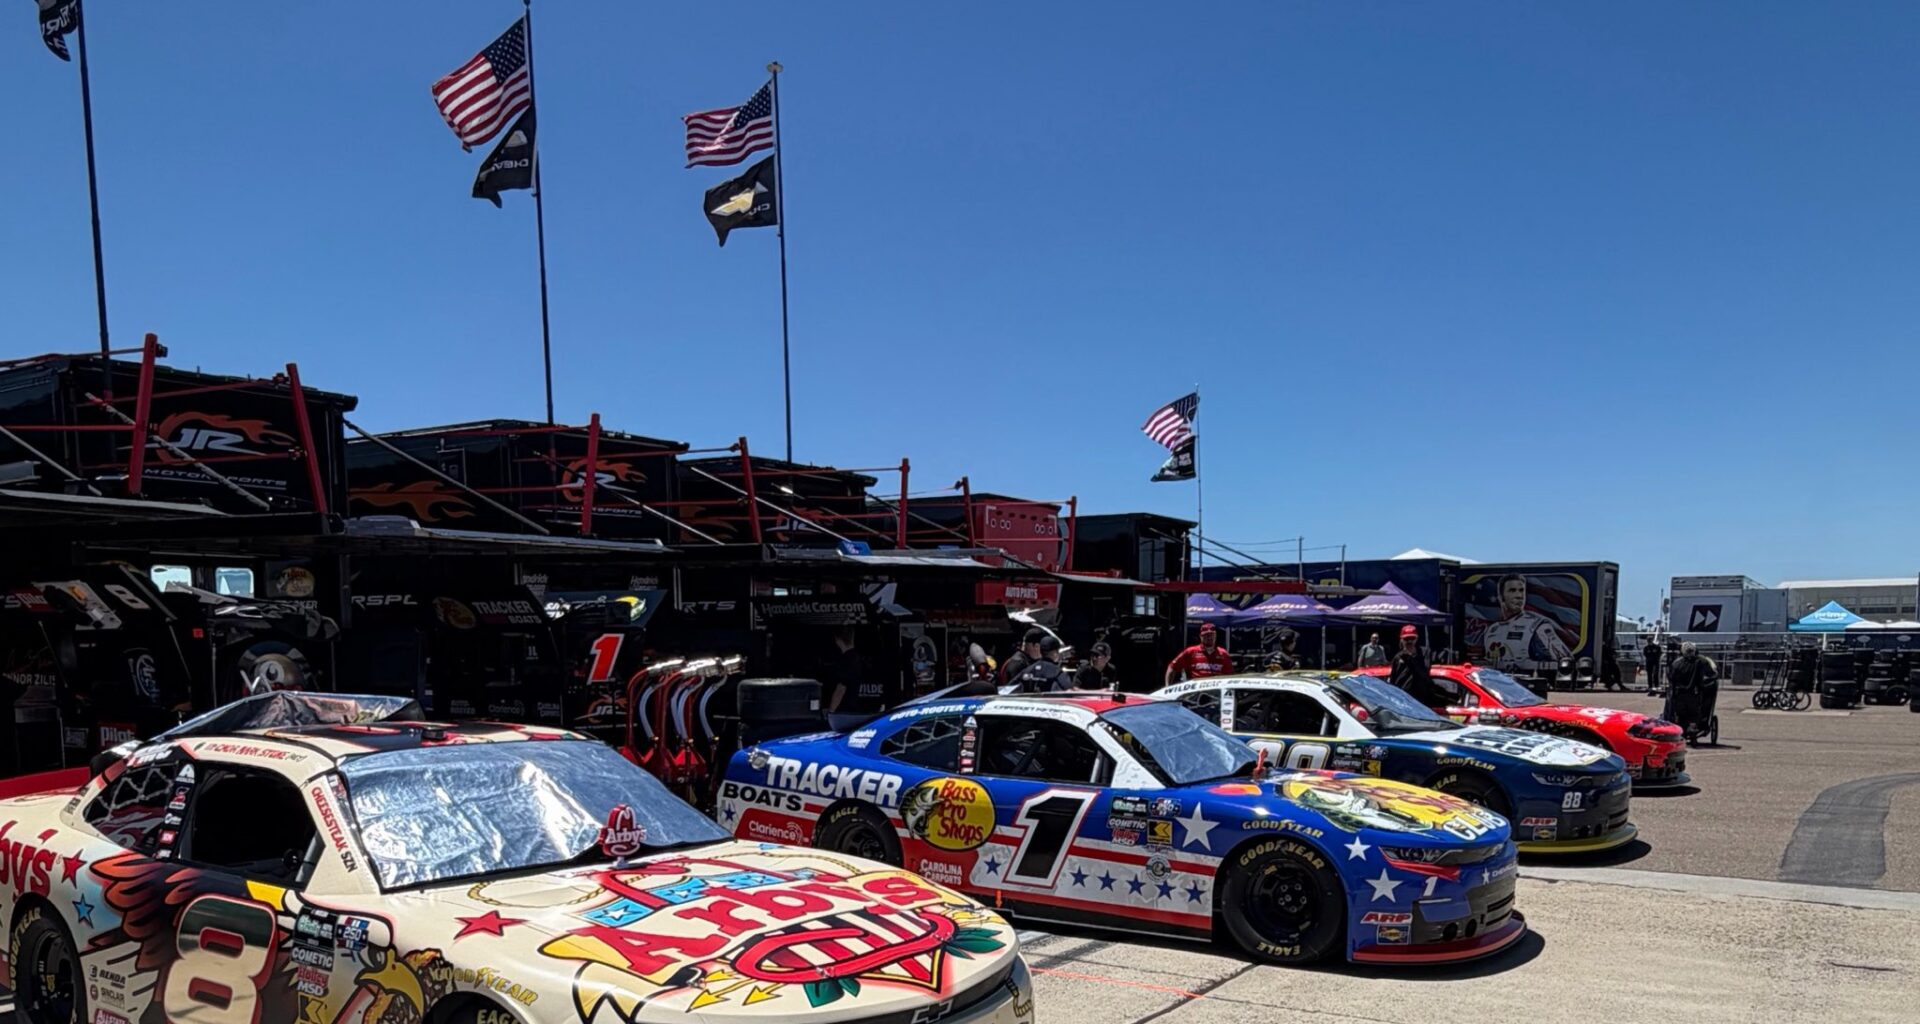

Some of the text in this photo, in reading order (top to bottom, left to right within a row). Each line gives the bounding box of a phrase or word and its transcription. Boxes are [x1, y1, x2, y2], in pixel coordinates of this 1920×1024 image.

[143, 467, 288, 487] MOTORPORTS
[470, 599, 535, 615] TRACKER
[586, 633, 625, 685] 1
[1435, 756, 1497, 772] GOODYEAR
[766, 756, 903, 808] TRACKER
[938, 780, 978, 804] Bass
[723, 783, 802, 812] BOATS
[1562, 791, 1583, 809] 88
[829, 806, 860, 824] EAGLE
[936, 802, 966, 823] Pro
[311, 787, 358, 873] CHEESESTEAK SZN
[748, 820, 797, 840] Clarience
[937, 820, 983, 848] Shops
[1242, 818, 1324, 839] GOODYEAR
[1443, 811, 1508, 841] CLUB
[605, 827, 647, 846] Arby's
[1003, 788, 1100, 888] 1
[1240, 839, 1326, 870] GOODYEAR
[920, 858, 962, 876] CAROLINA
[923, 871, 962, 886] CARPORTS
[1422, 876, 1438, 896] 1
[568, 876, 942, 976] Arby's
[1362, 912, 1409, 923] ARP
[342, 926, 362, 942] 250
[164, 892, 279, 1024] 8
[291, 947, 333, 968] COMETIC
[1257, 941, 1301, 956] EAGLE
[297, 980, 323, 996] MSD
